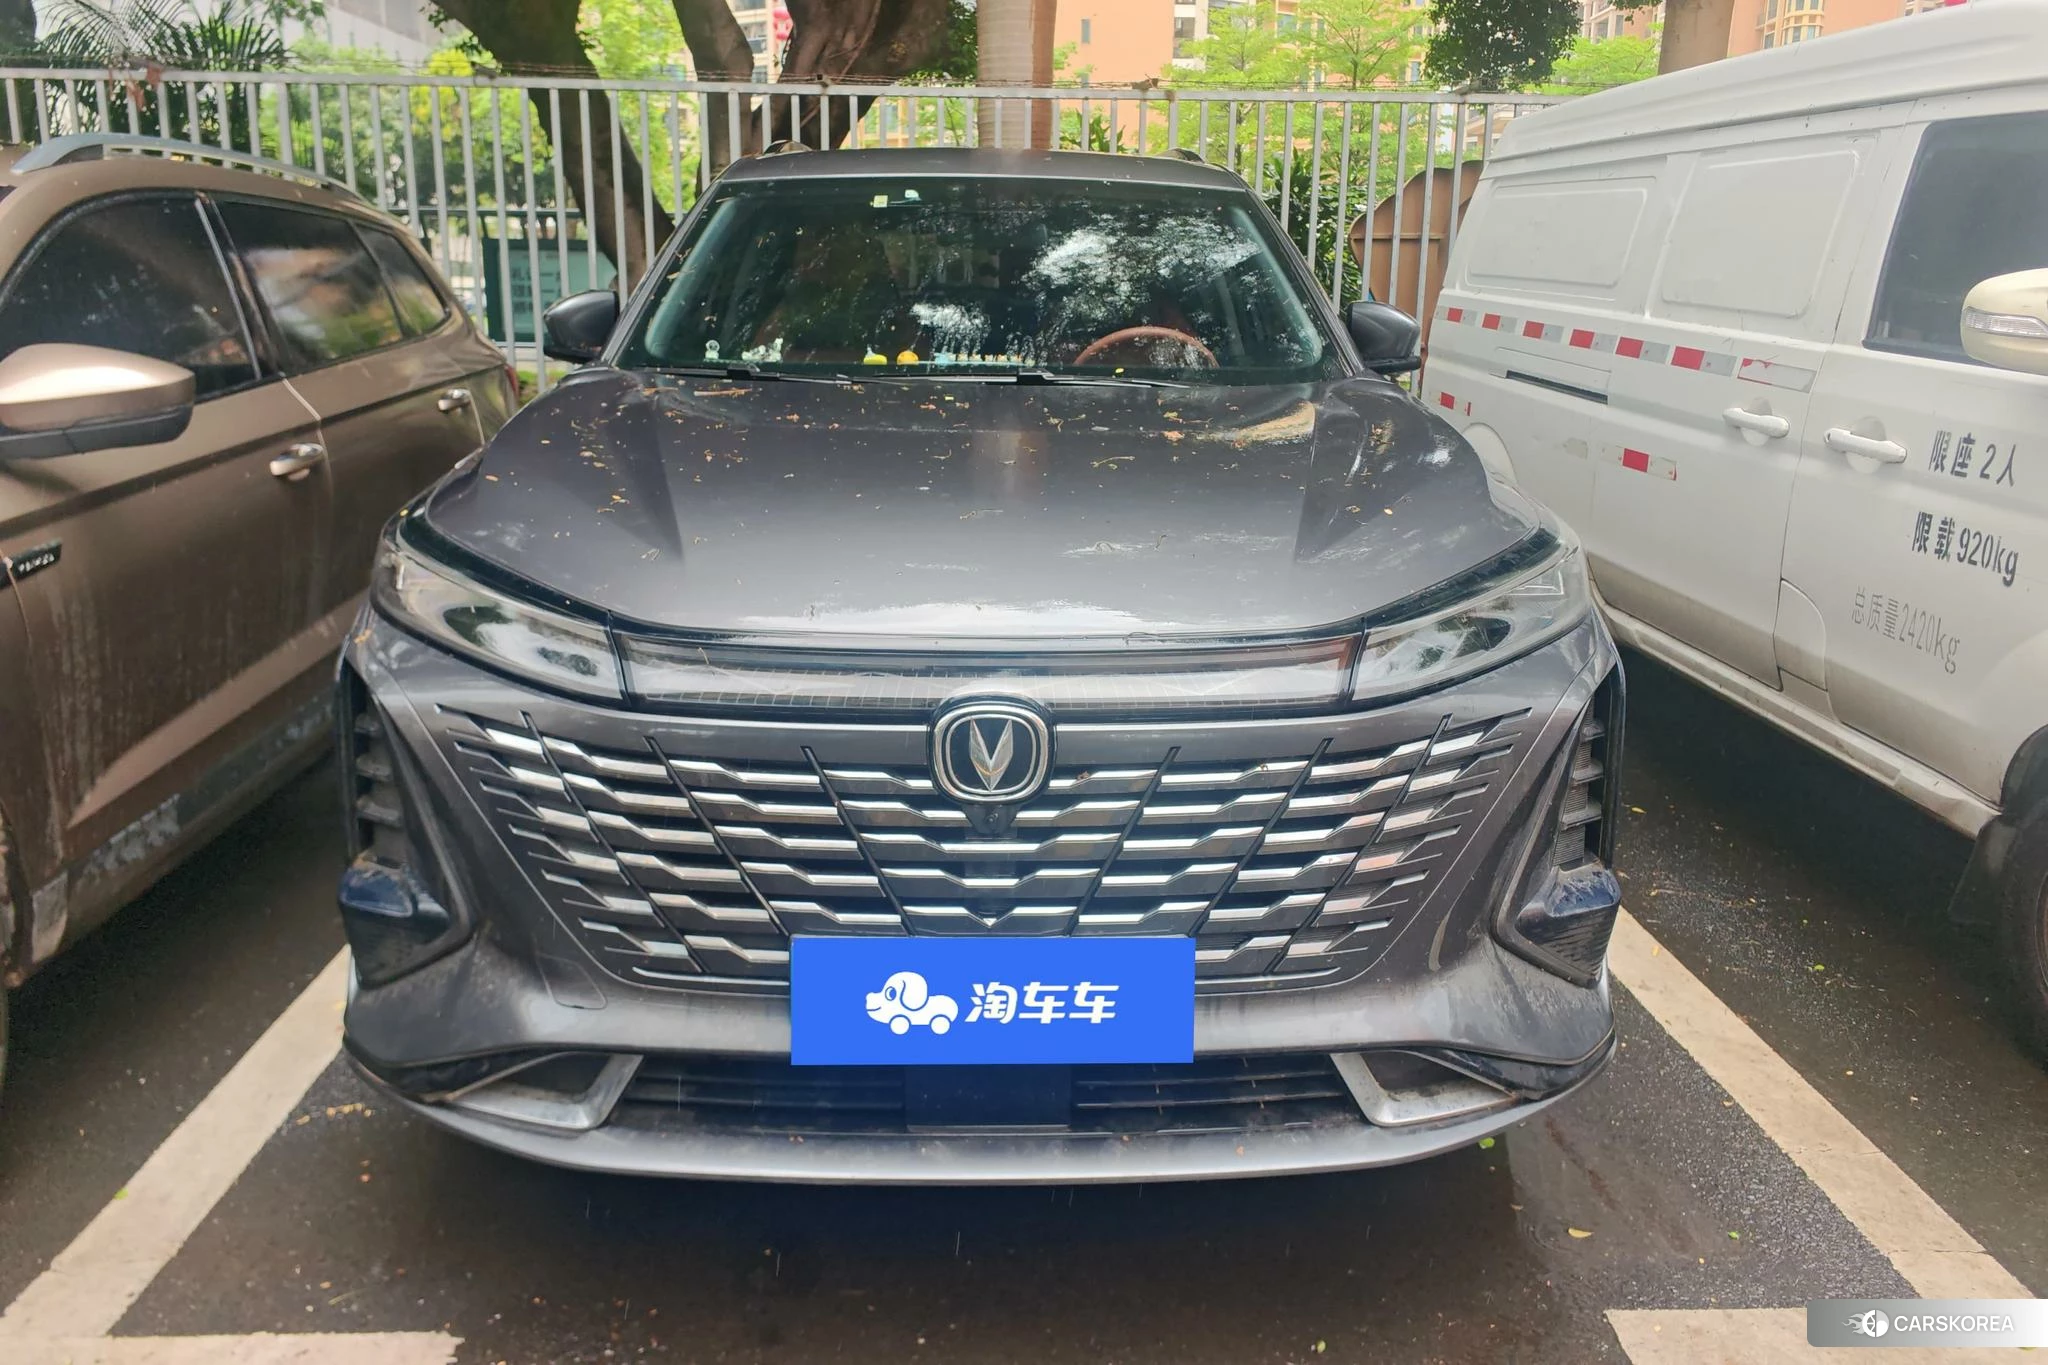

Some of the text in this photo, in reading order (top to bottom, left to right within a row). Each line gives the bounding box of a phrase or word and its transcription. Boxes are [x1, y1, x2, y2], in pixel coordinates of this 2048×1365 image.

[1911, 511, 2019, 587] 限载920kg
[1851, 585, 1961, 674] 总质量2420kg
